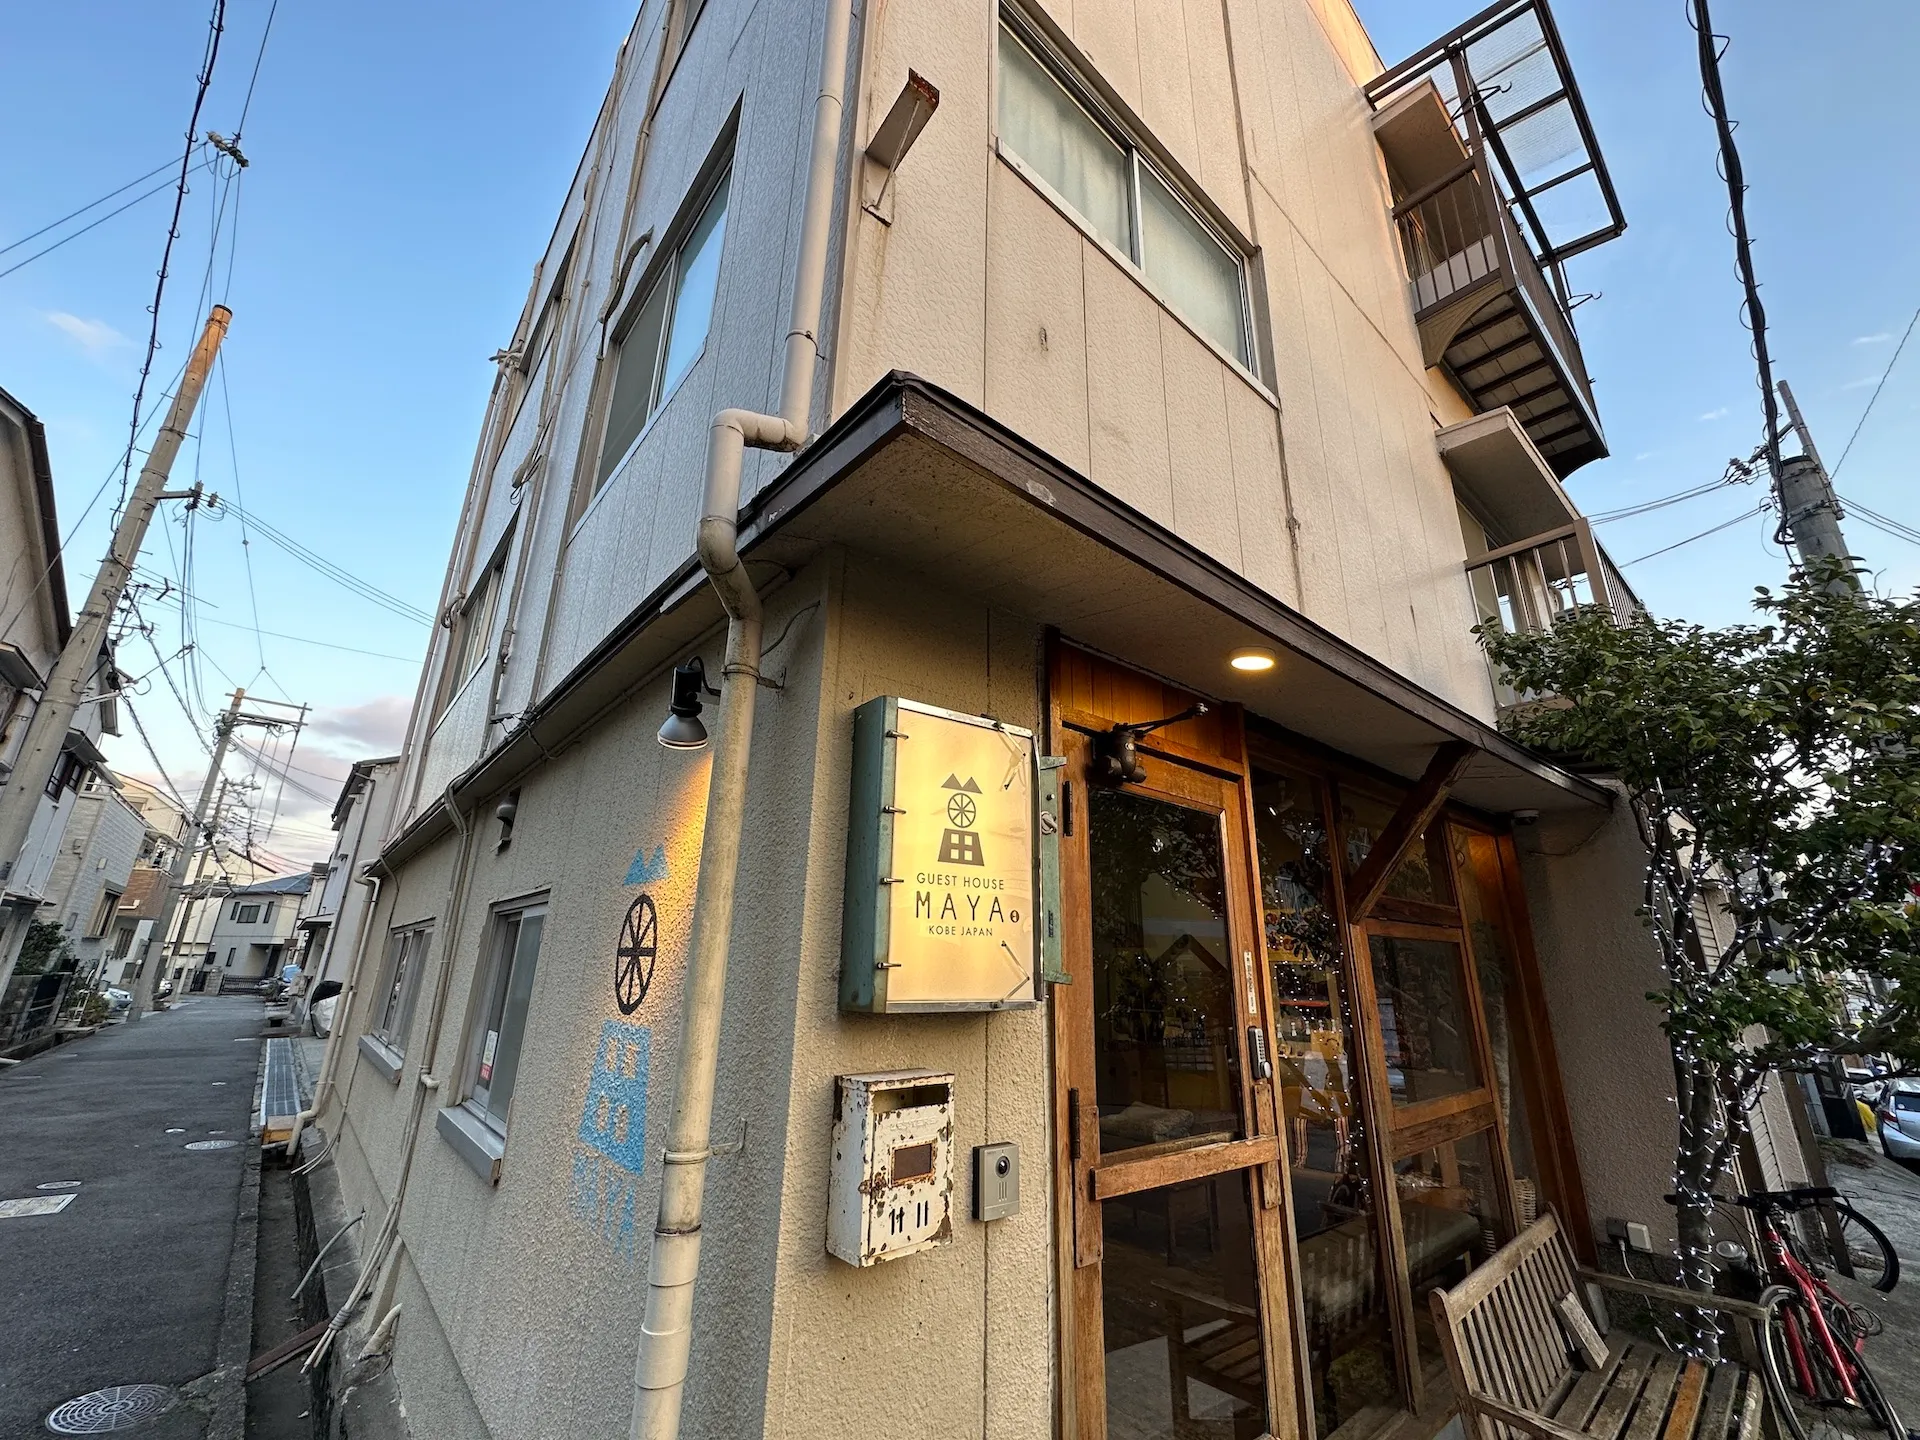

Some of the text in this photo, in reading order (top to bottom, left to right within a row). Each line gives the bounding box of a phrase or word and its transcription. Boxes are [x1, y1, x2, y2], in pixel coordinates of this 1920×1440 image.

[916, 872, 1004, 890] GUEST HOUSE
[916, 890, 1004, 923] MAYA
[928, 925, 993, 937] KOBE JAPAN
